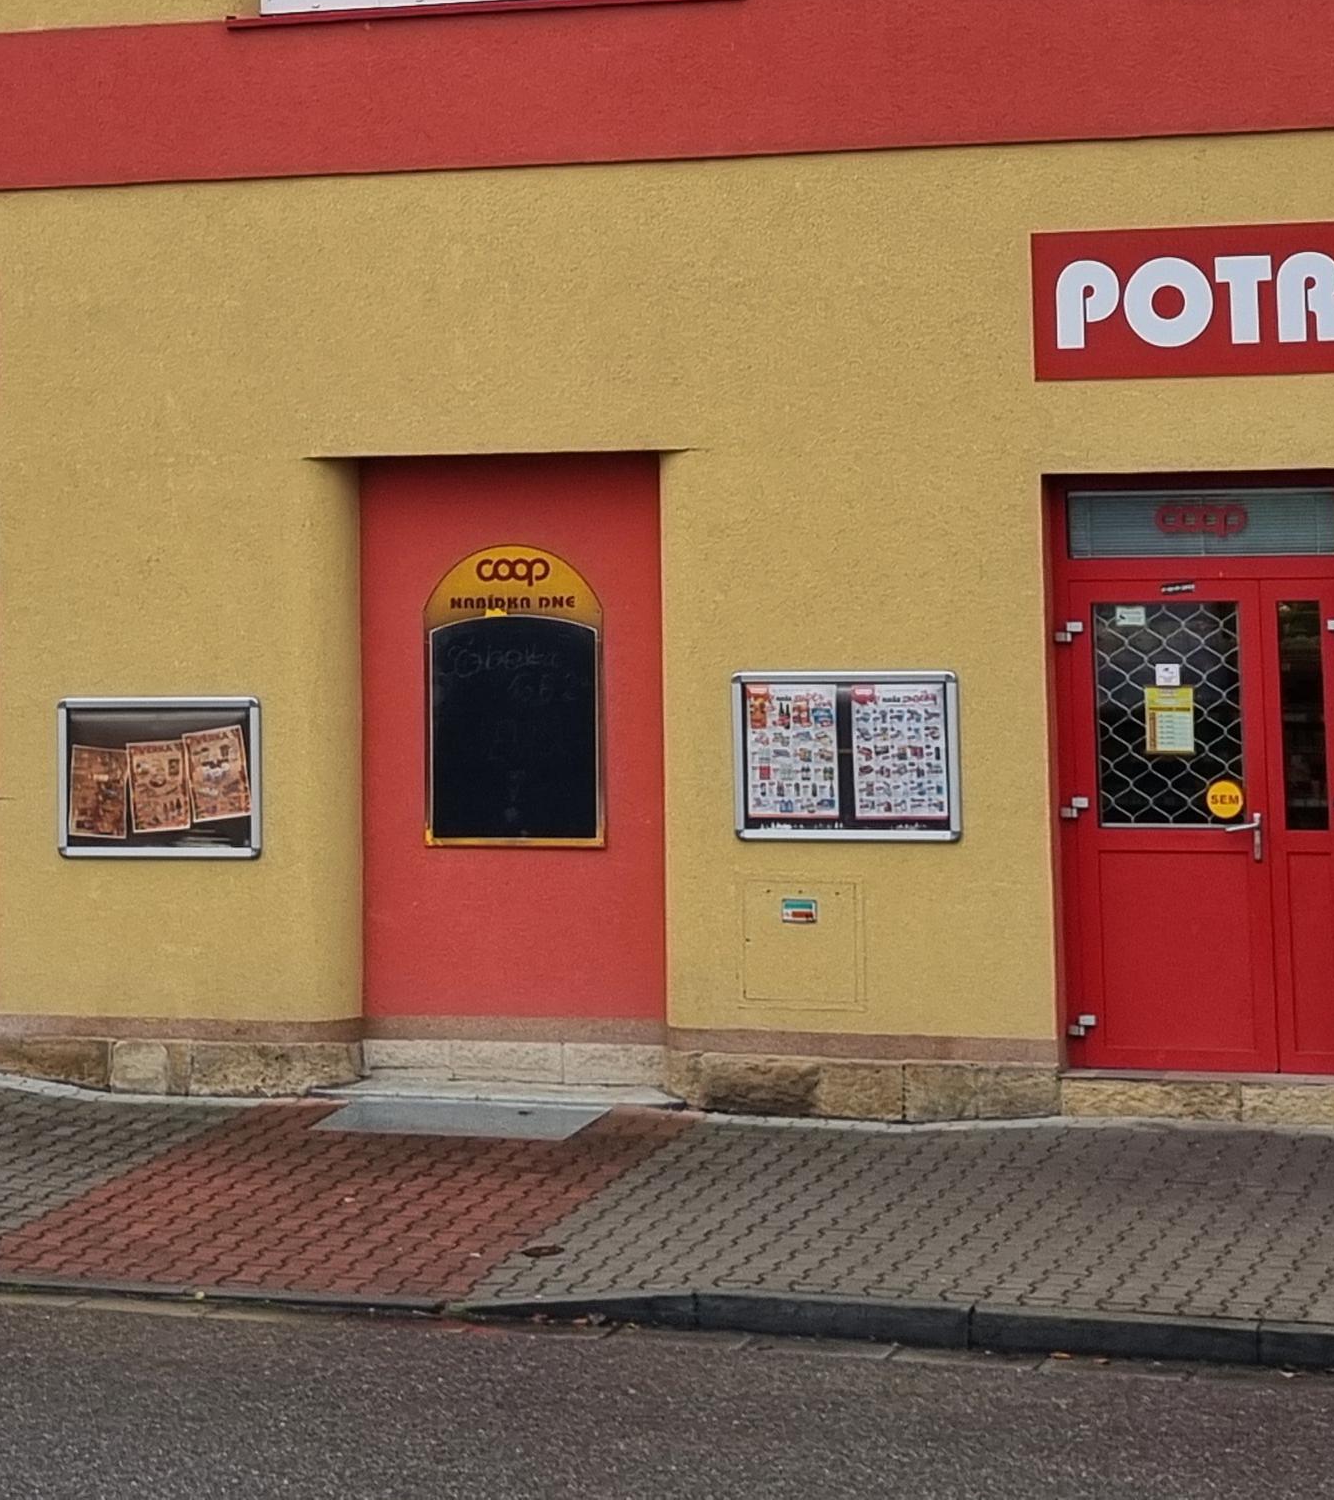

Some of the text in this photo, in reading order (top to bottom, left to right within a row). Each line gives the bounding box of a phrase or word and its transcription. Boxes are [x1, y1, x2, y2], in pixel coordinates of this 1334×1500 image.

[1154, 504, 1247, 538] coop
[476, 557, 550, 587] coop
[538, 596, 576, 609] DNE
[1211, 794, 1240, 805] SEM
